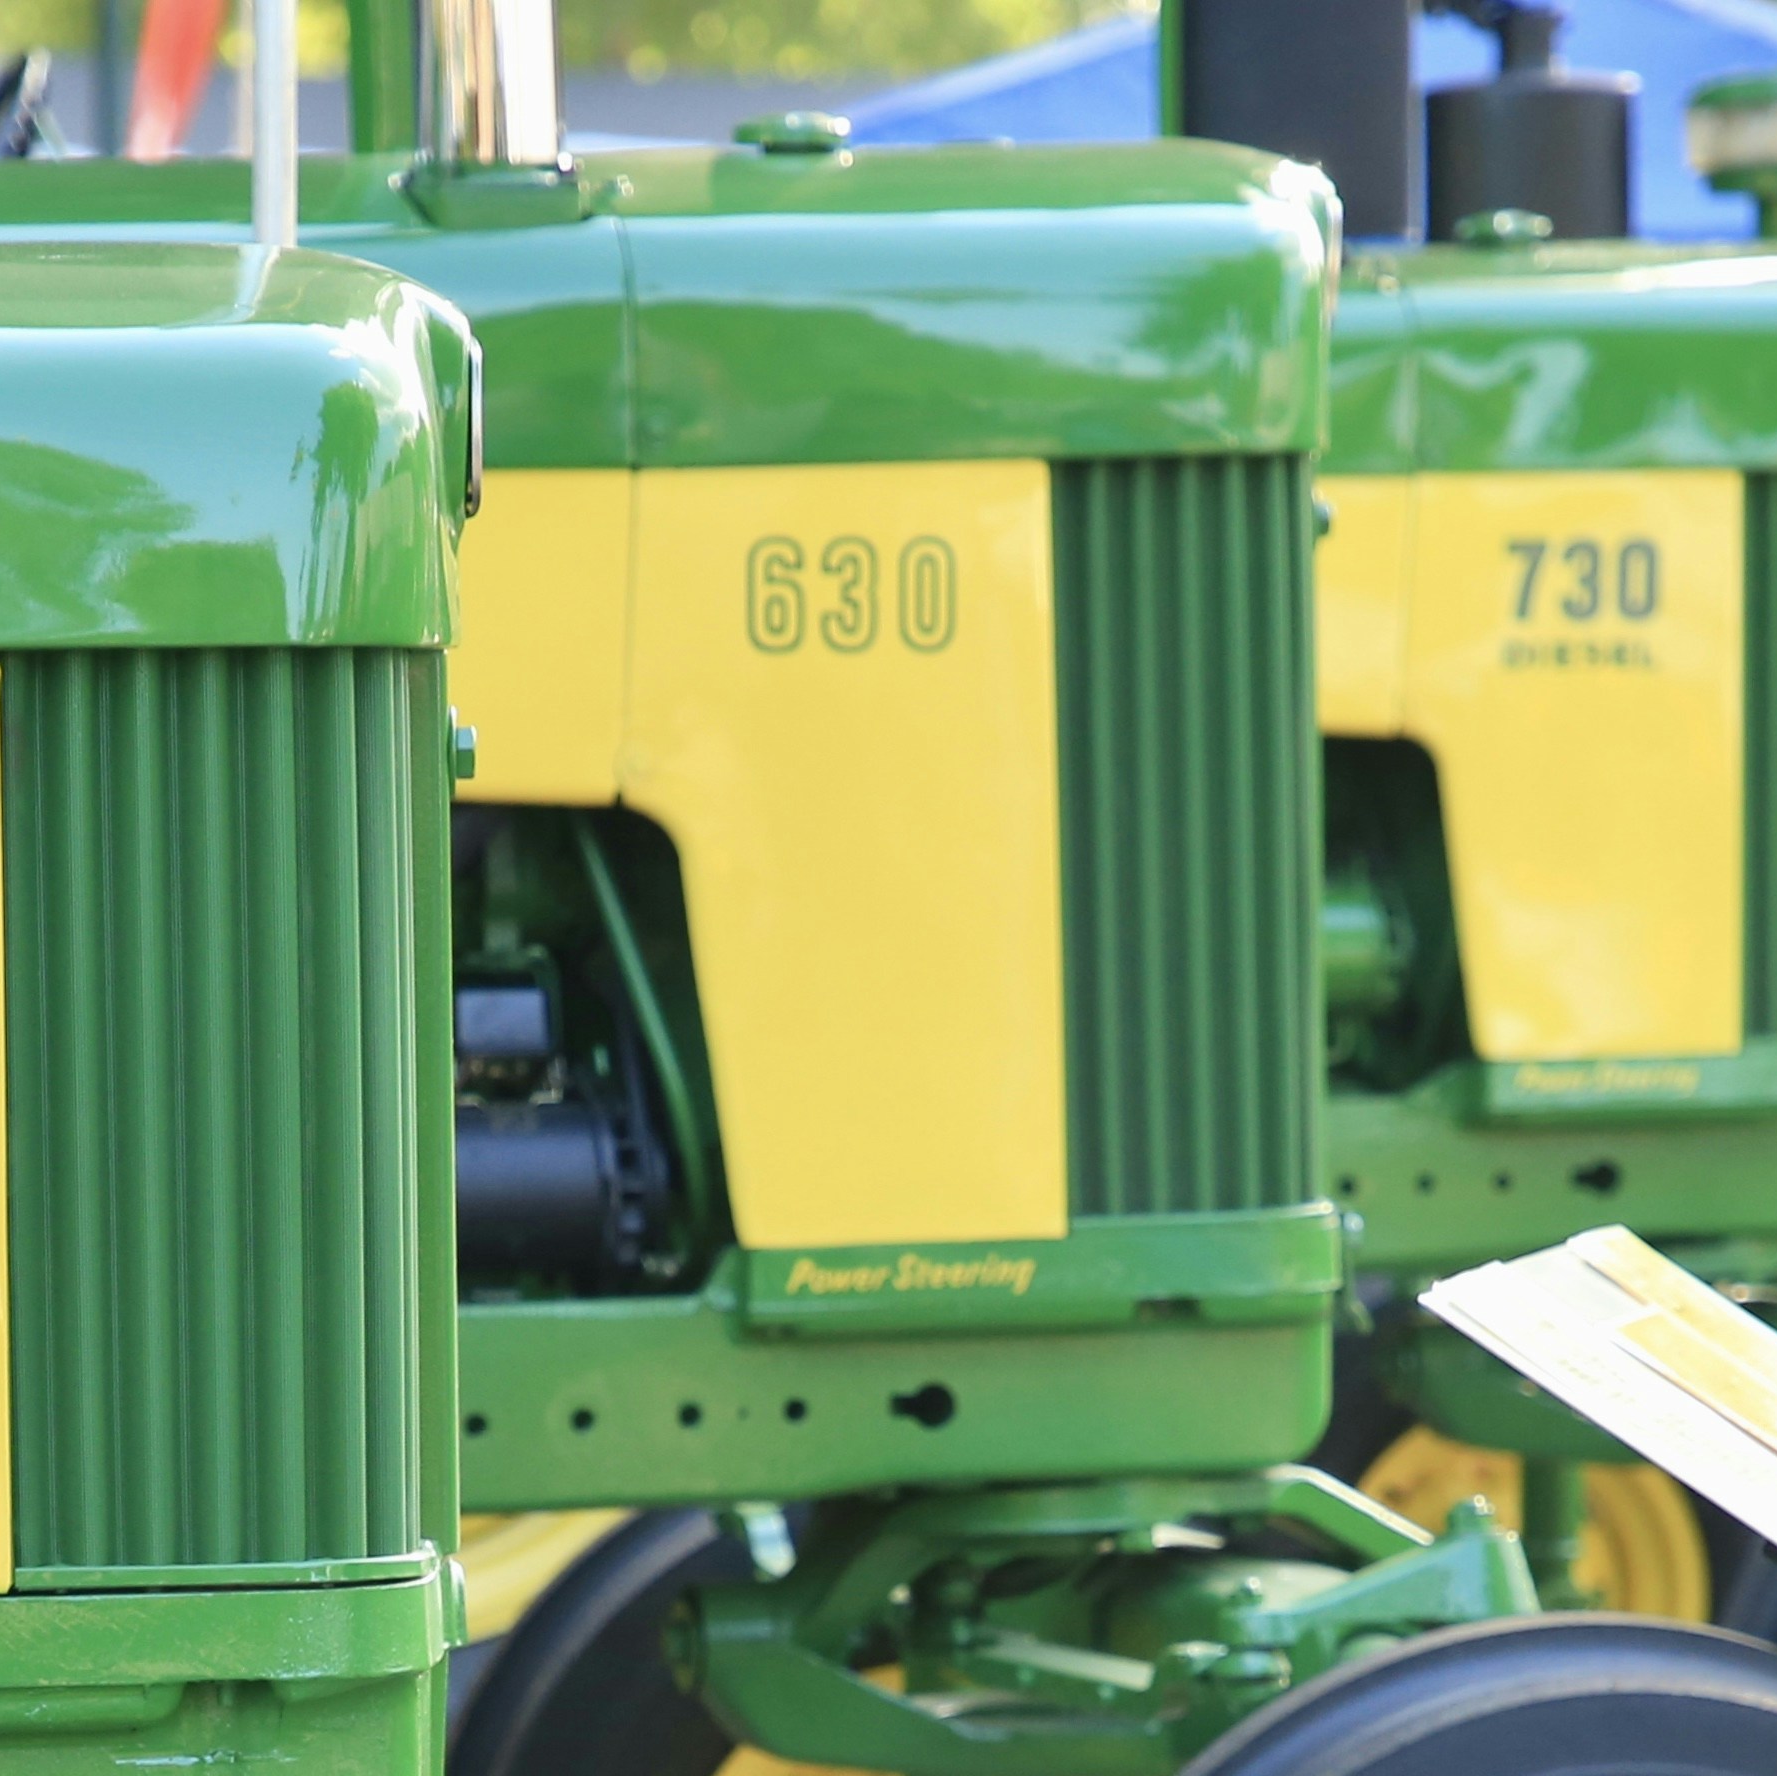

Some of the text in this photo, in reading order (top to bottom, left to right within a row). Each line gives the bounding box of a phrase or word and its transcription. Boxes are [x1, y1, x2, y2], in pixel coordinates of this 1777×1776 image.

[746, 534, 958, 654] 630
[1506, 538, 1662, 620] 730
[785, 1251, 1036, 1296] Power Steering
